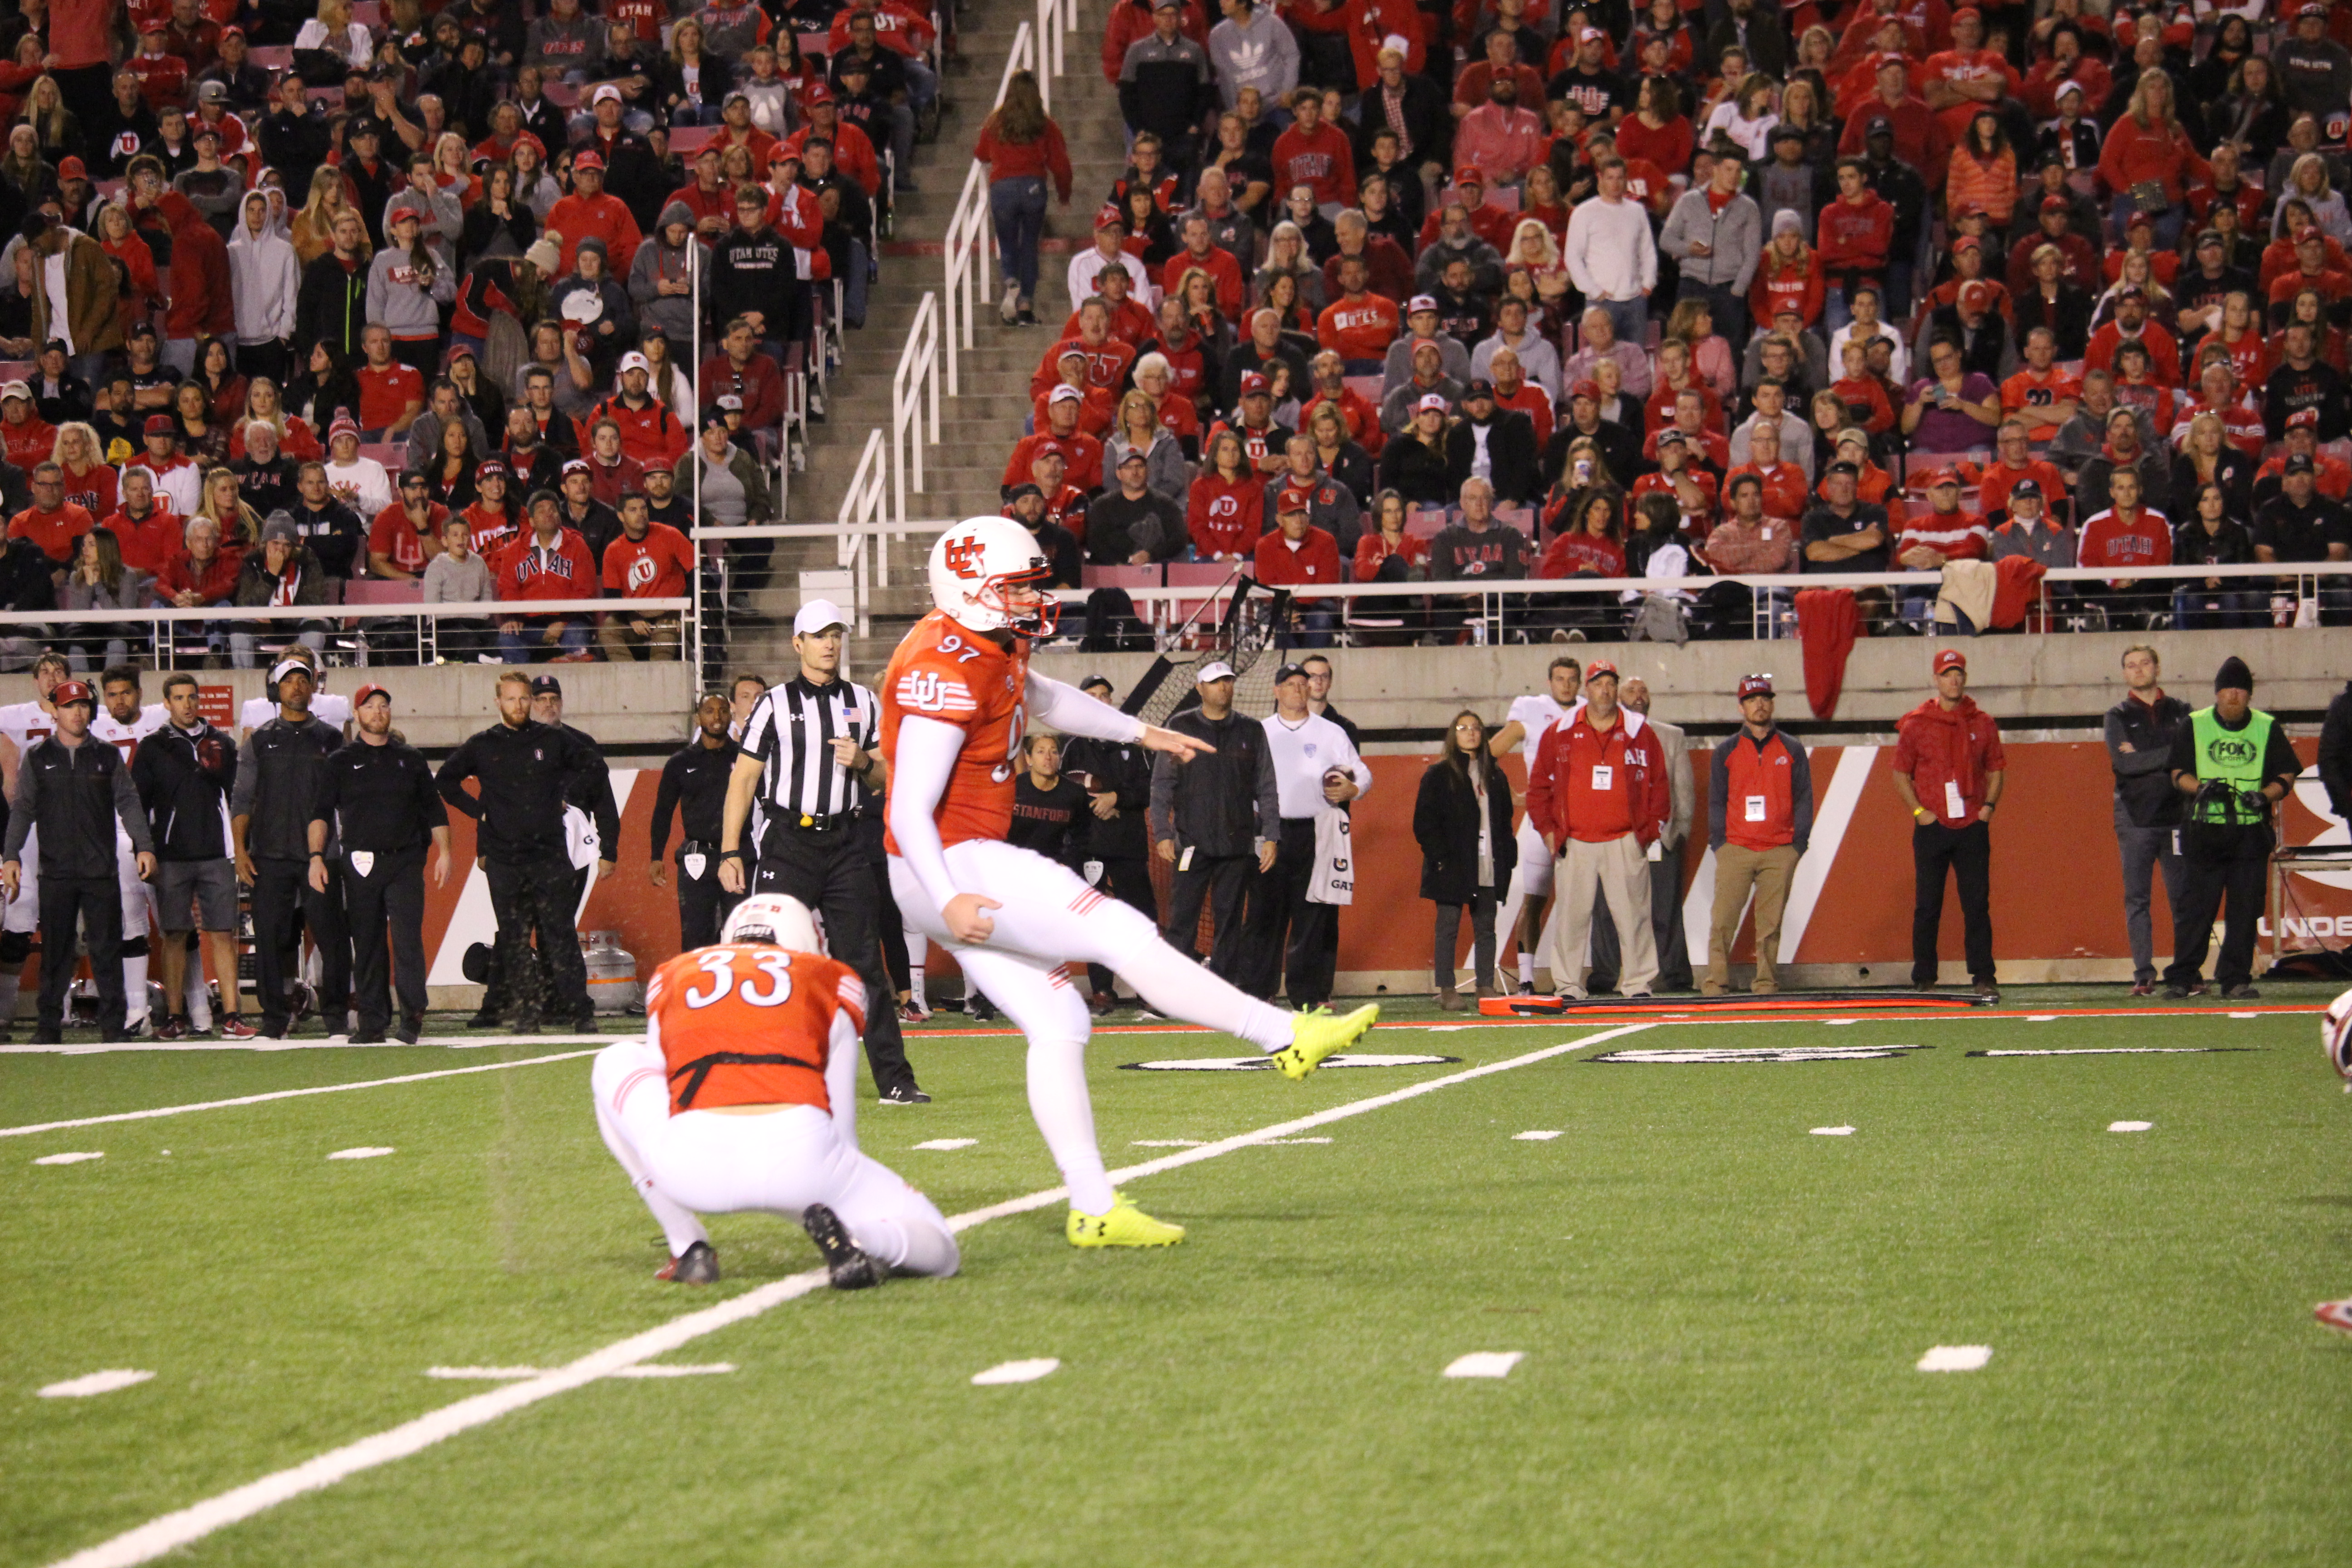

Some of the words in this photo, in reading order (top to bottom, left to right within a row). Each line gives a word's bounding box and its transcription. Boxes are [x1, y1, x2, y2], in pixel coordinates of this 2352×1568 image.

[617, 4, 651, 17] UTAH
[2106, 536, 2152, 556] UTAH
[516, 554, 573, 583] UTAH
[637, 563, 651, 579] U
[936, 635, 980, 663] 97
[2218, 742, 2246, 756] FOX
[1014, 804, 1070, 822] STANFORD
[583, 835, 594, 845] G
[1333, 858, 1348, 872] G
[685, 951, 792, 1009] 33
